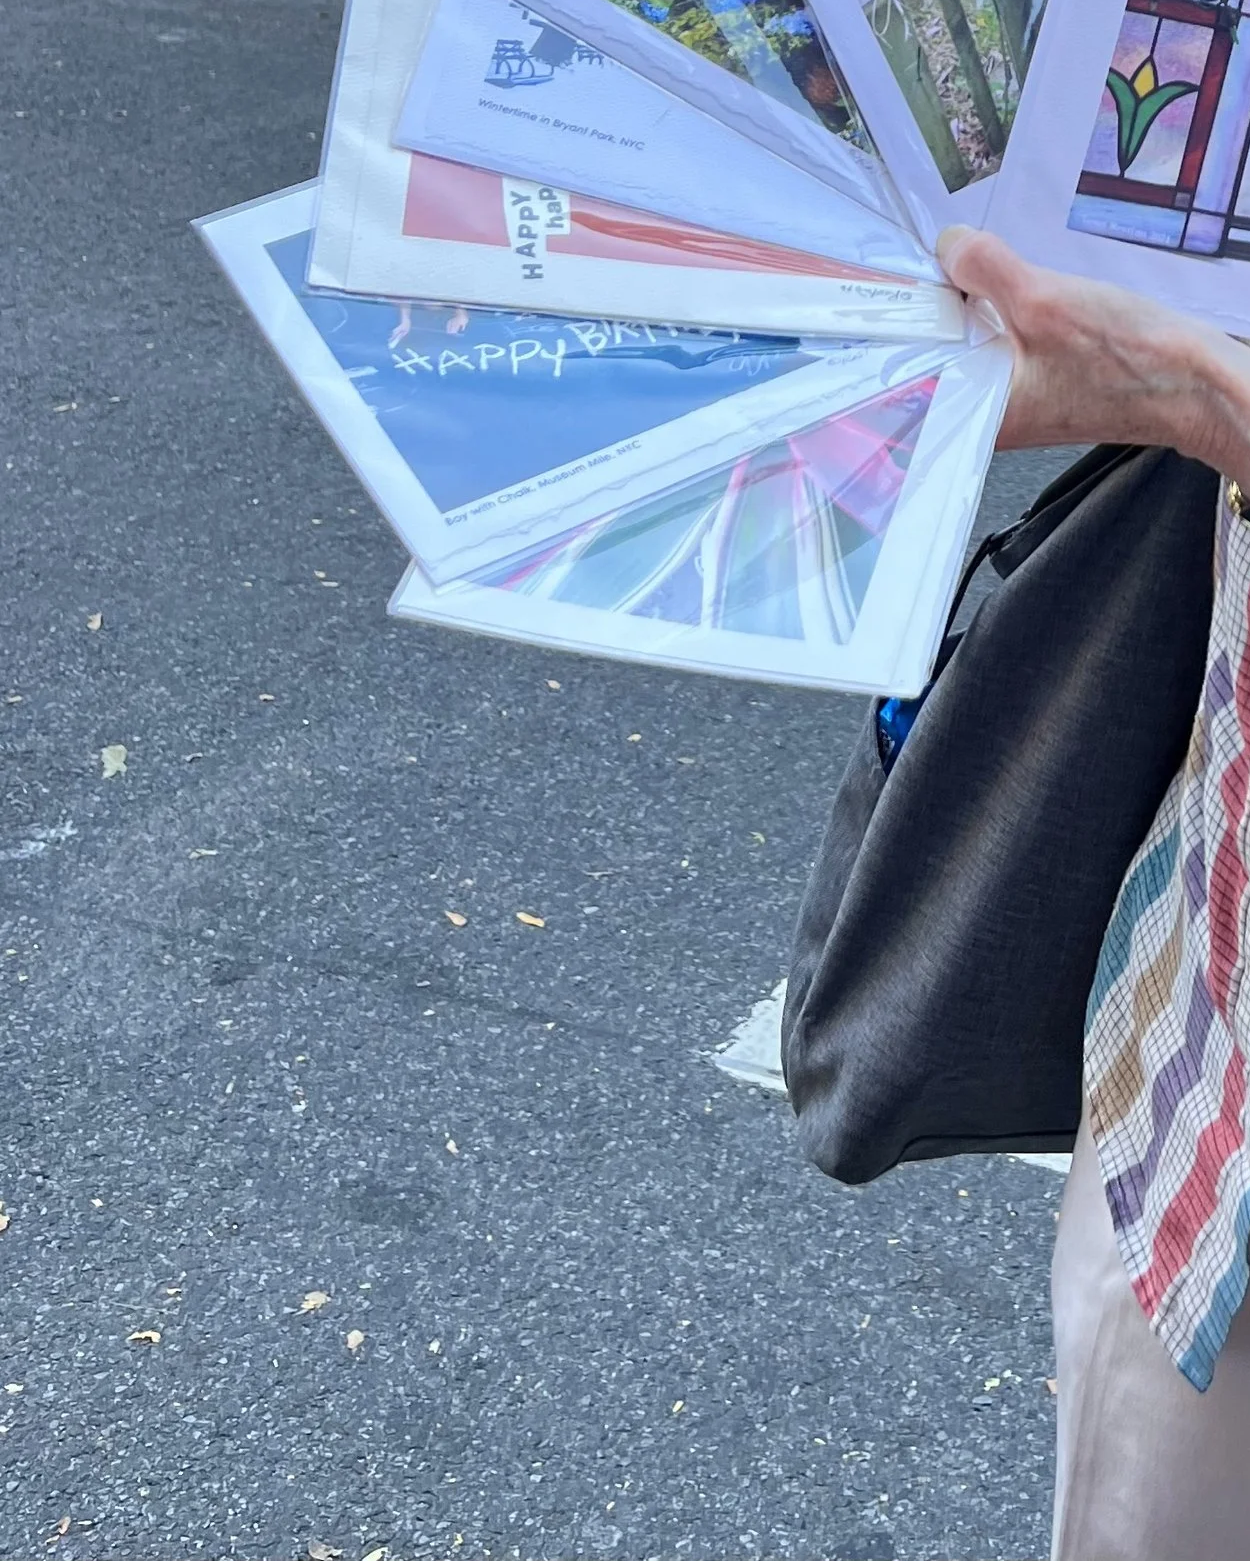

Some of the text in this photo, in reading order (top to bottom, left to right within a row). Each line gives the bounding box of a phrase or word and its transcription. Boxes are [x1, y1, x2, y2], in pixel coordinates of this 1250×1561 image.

[478, 97, 539, 122] Wintertime
[540, 115, 551, 125] in
[552, 118, 589, 136] Bryant
[619, 137, 646, 151] NYC
[538, 186, 565, 229] hap
[509, 190, 545, 280] HAPPY
[391, 338, 568, 377] HAPPY
[444, 512, 469, 527] Boy
[469, 500, 497, 516] with
[537, 462, 587, 489] Museum
[615, 439, 643, 456] NYC
